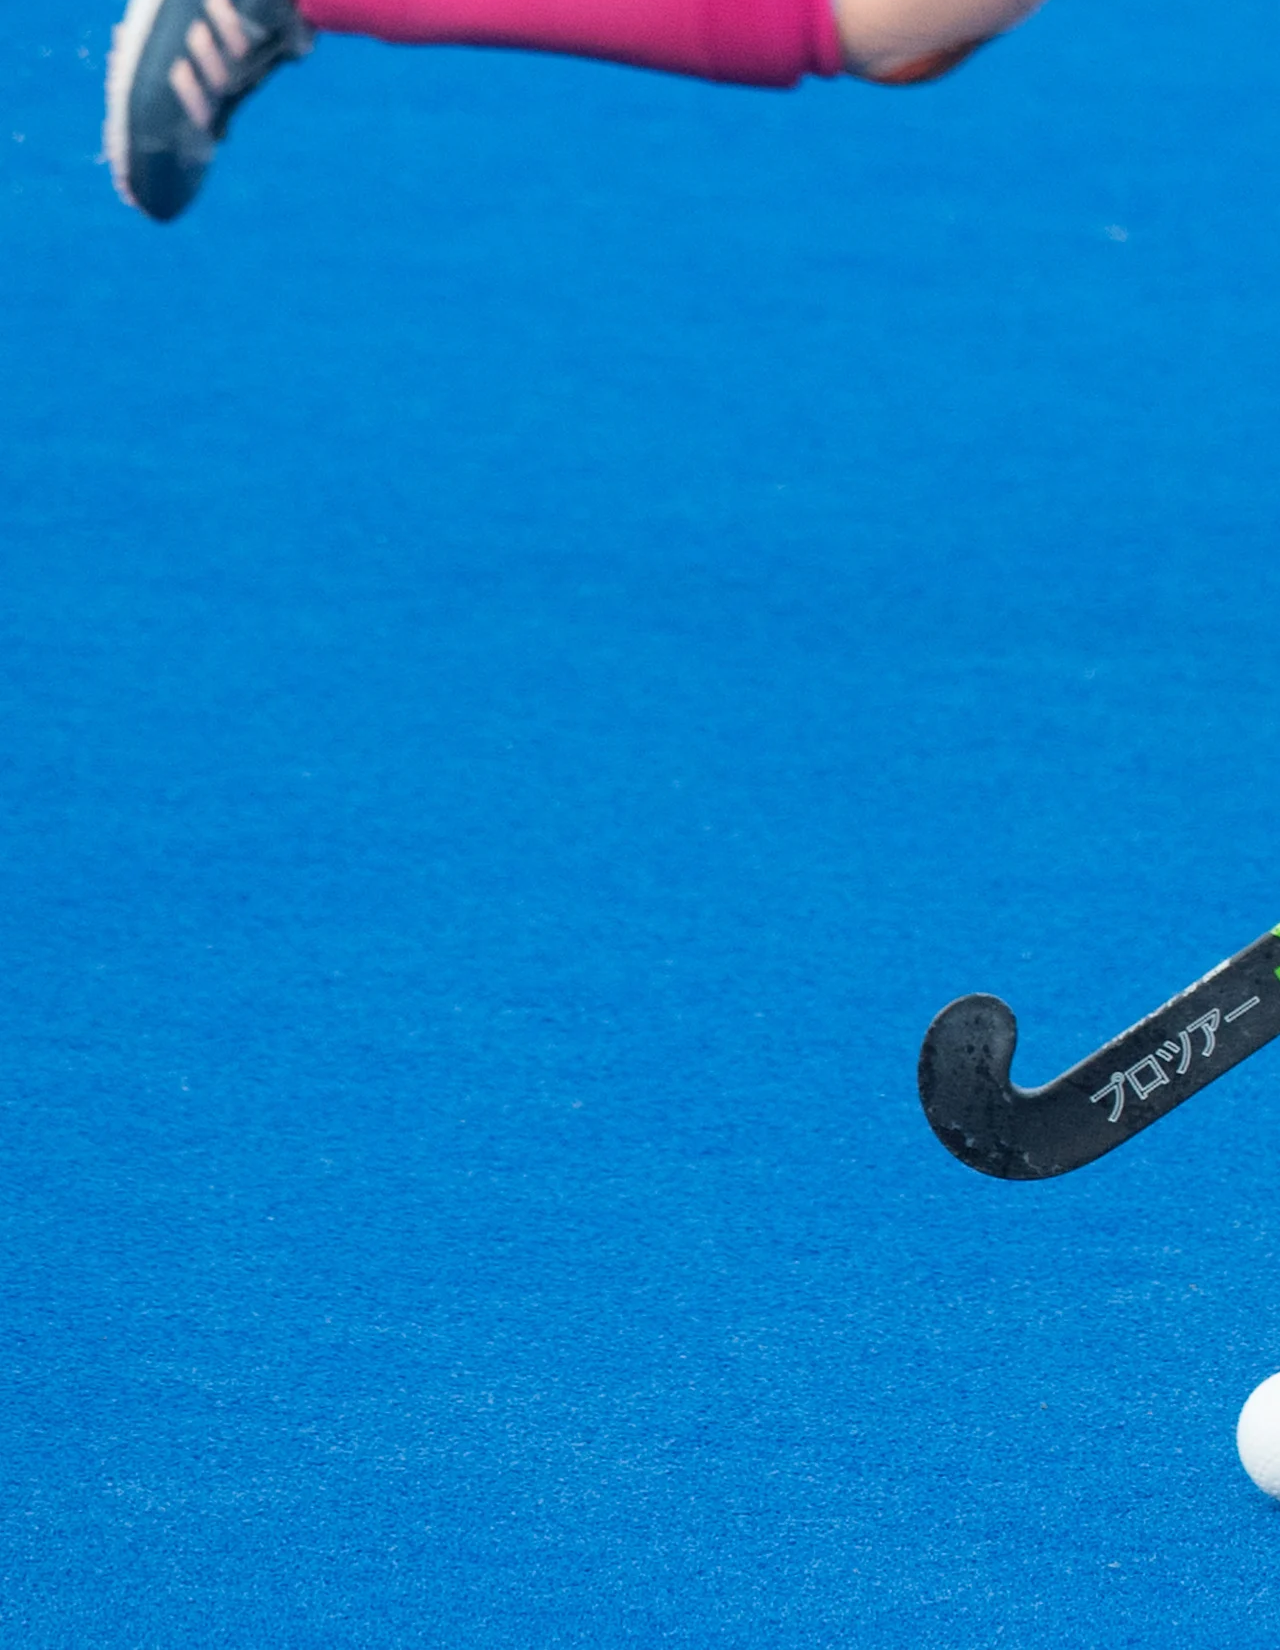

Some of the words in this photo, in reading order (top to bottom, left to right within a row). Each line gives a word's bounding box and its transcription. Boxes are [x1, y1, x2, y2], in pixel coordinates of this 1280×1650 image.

[1089, 995, 1261, 1124] プロツアー
